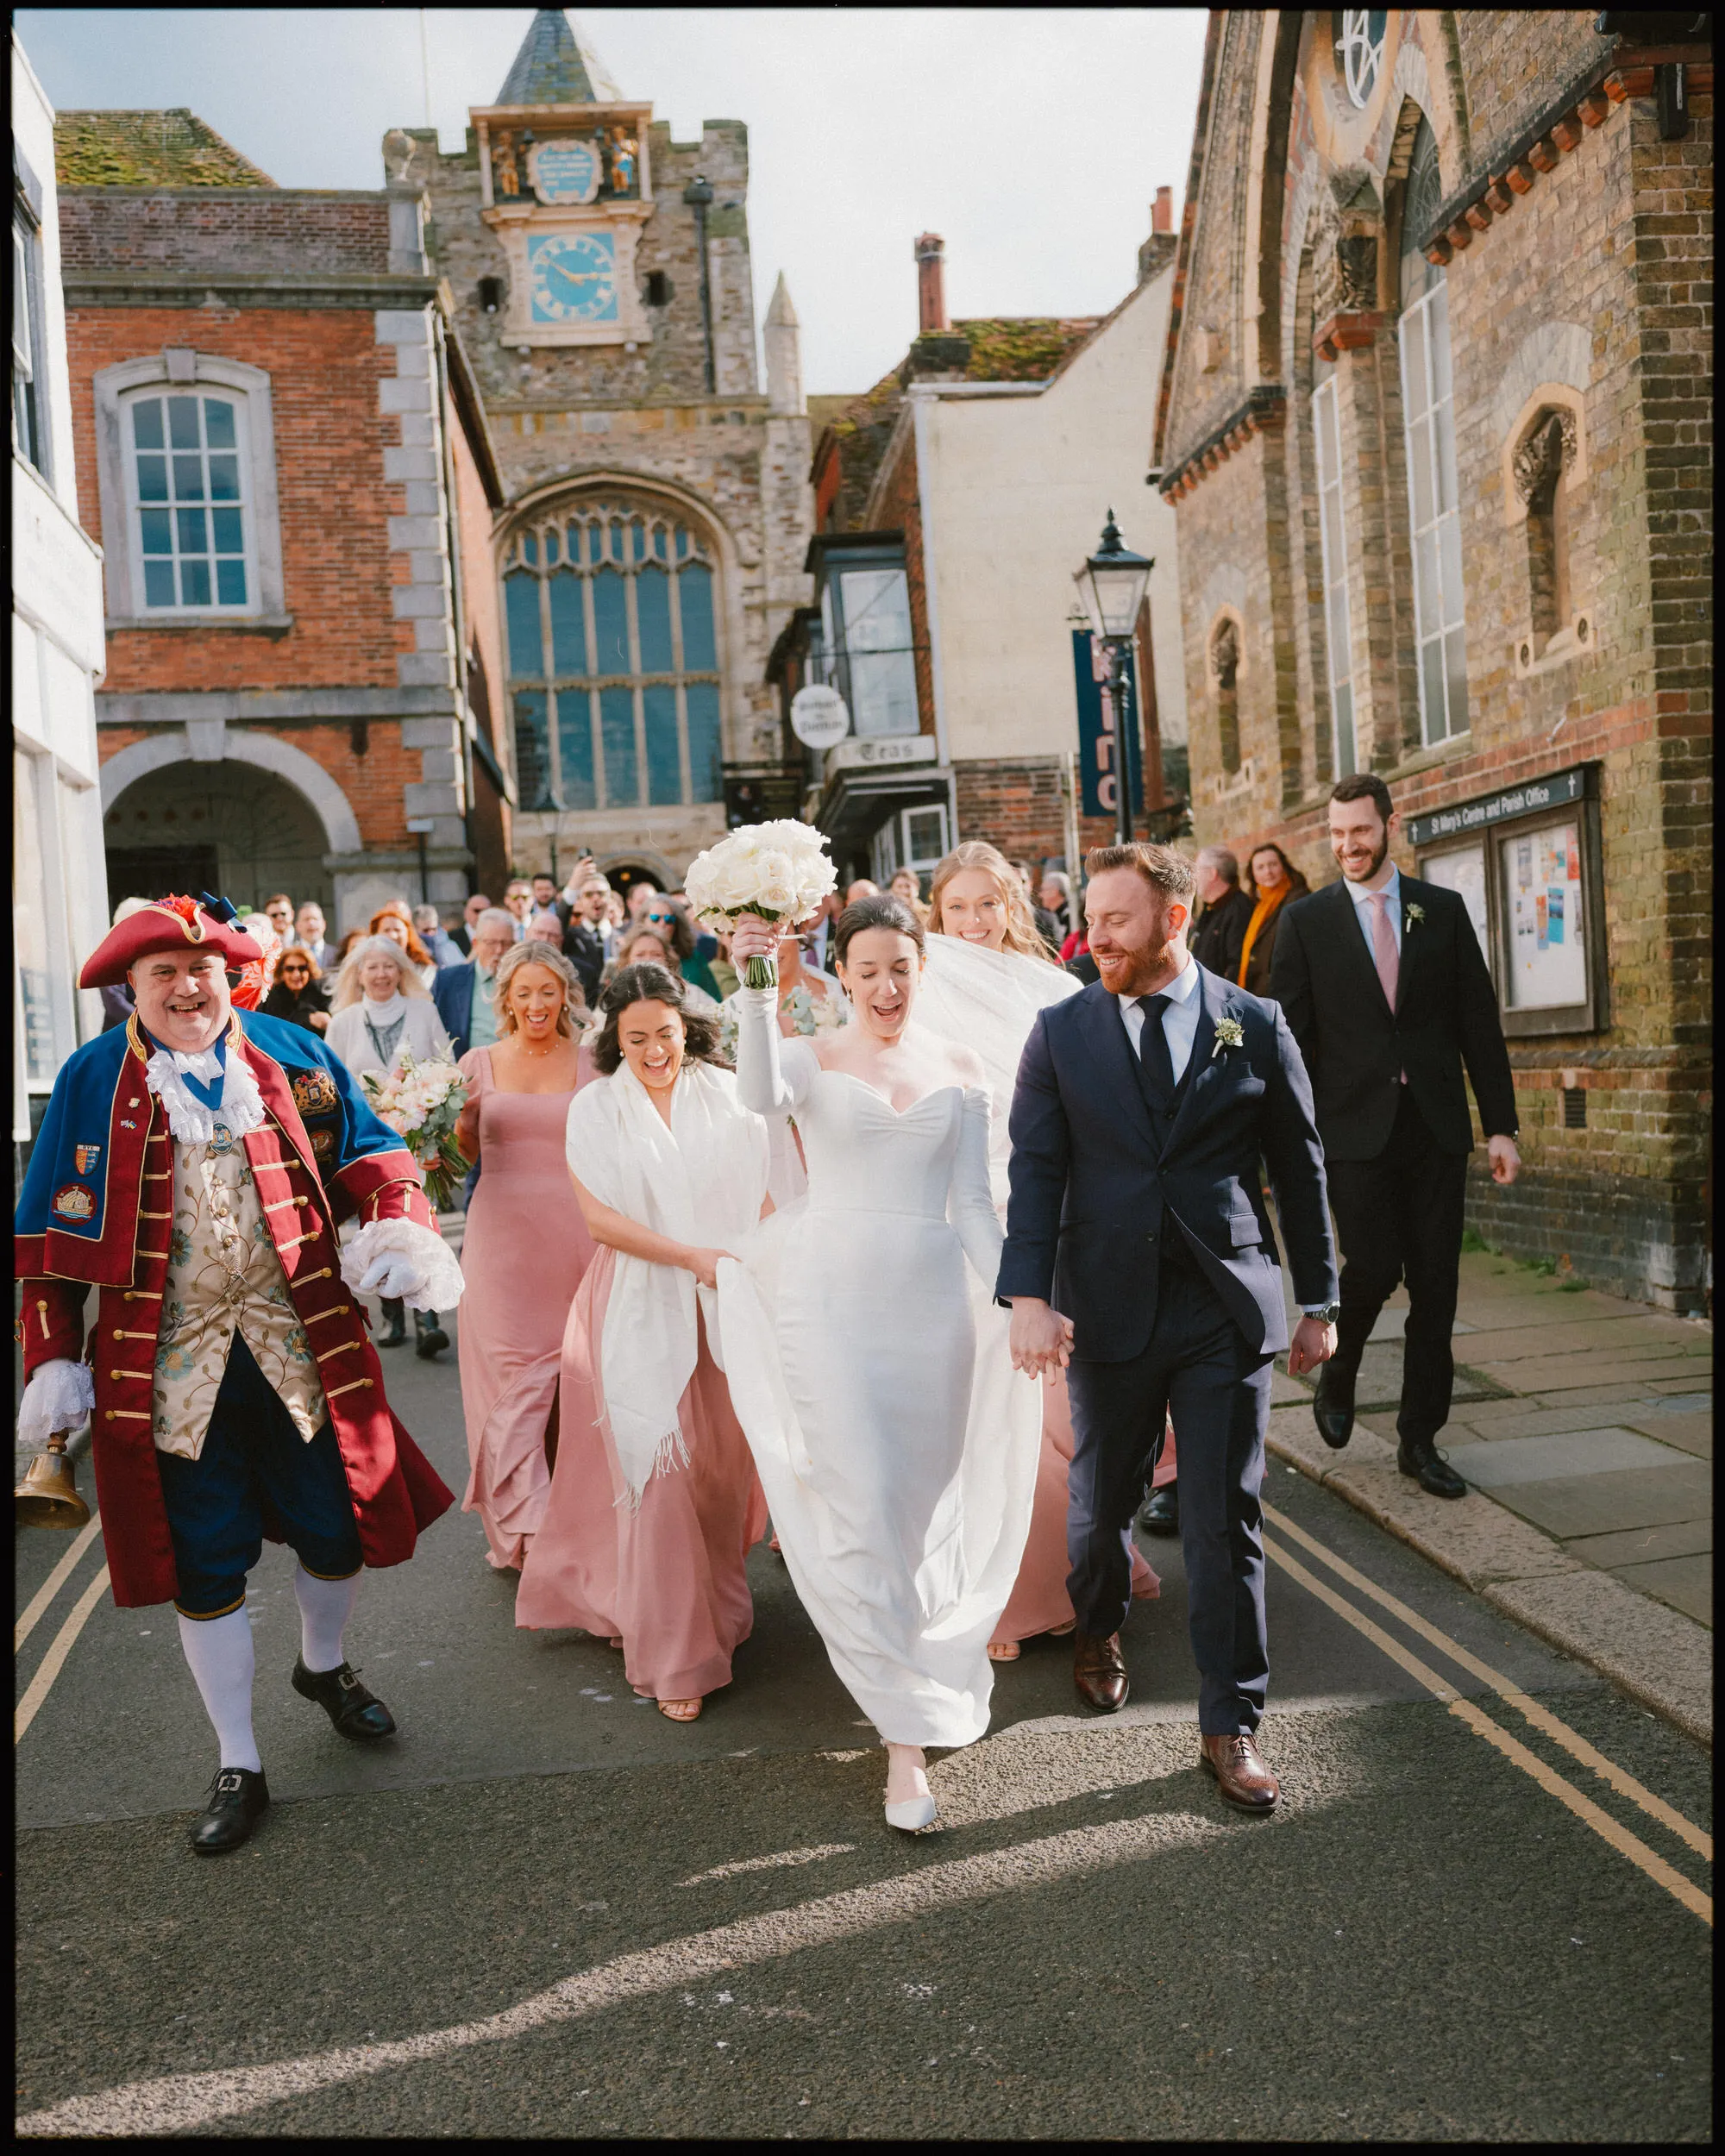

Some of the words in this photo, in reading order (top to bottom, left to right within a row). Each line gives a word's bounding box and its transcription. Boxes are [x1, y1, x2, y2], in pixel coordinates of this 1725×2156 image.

[1431, 817, 1440, 835] St
[1440, 812, 1462, 832] Mary's
[1462, 805, 1485, 825] Centre
[1486, 799, 1501, 818] and
[1501, 792, 1525, 814] Parish
[1526, 787, 1550, 806] Office
